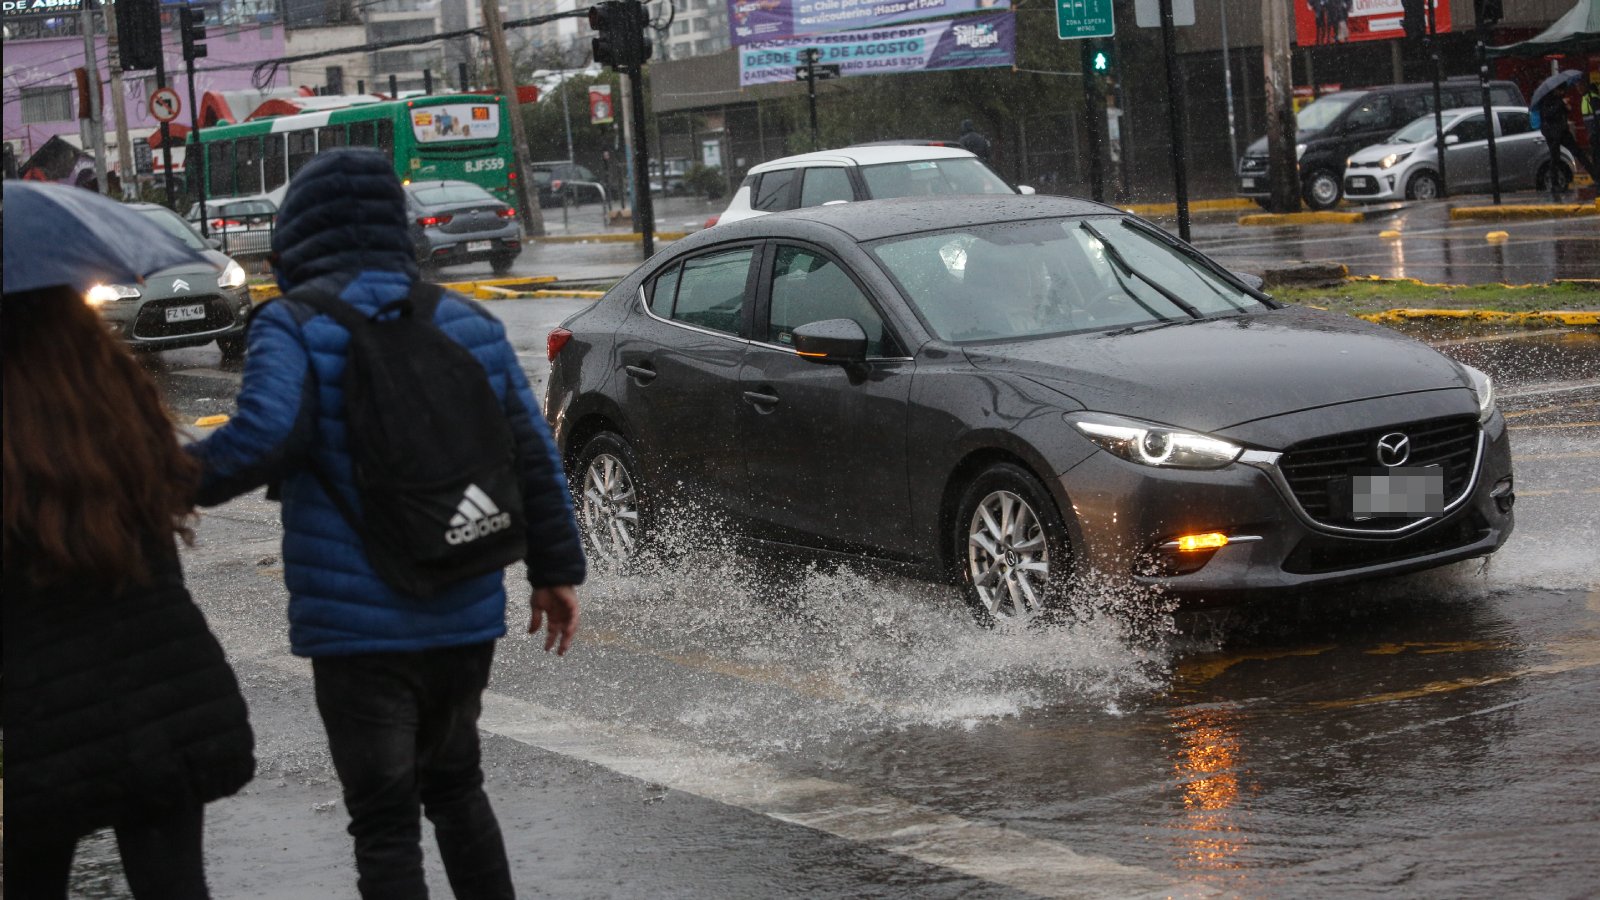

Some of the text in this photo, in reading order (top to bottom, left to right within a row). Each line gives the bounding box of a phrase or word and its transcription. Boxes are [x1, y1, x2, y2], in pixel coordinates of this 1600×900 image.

[3, 1, 27, 10] DE
[800, 5, 813, 13] en
[815, 1, 839, 11] Chile
[908, 0, 918, 10] el
[747, 51, 791, 66] DESDE
[830, 46, 850, 58] DE
[854, 40, 919, 57] AGOSTO
[866, 57, 898, 68] SALAS
[464, 158, 504, 172] BJFS59
[445, 512, 511, 545] adidas
